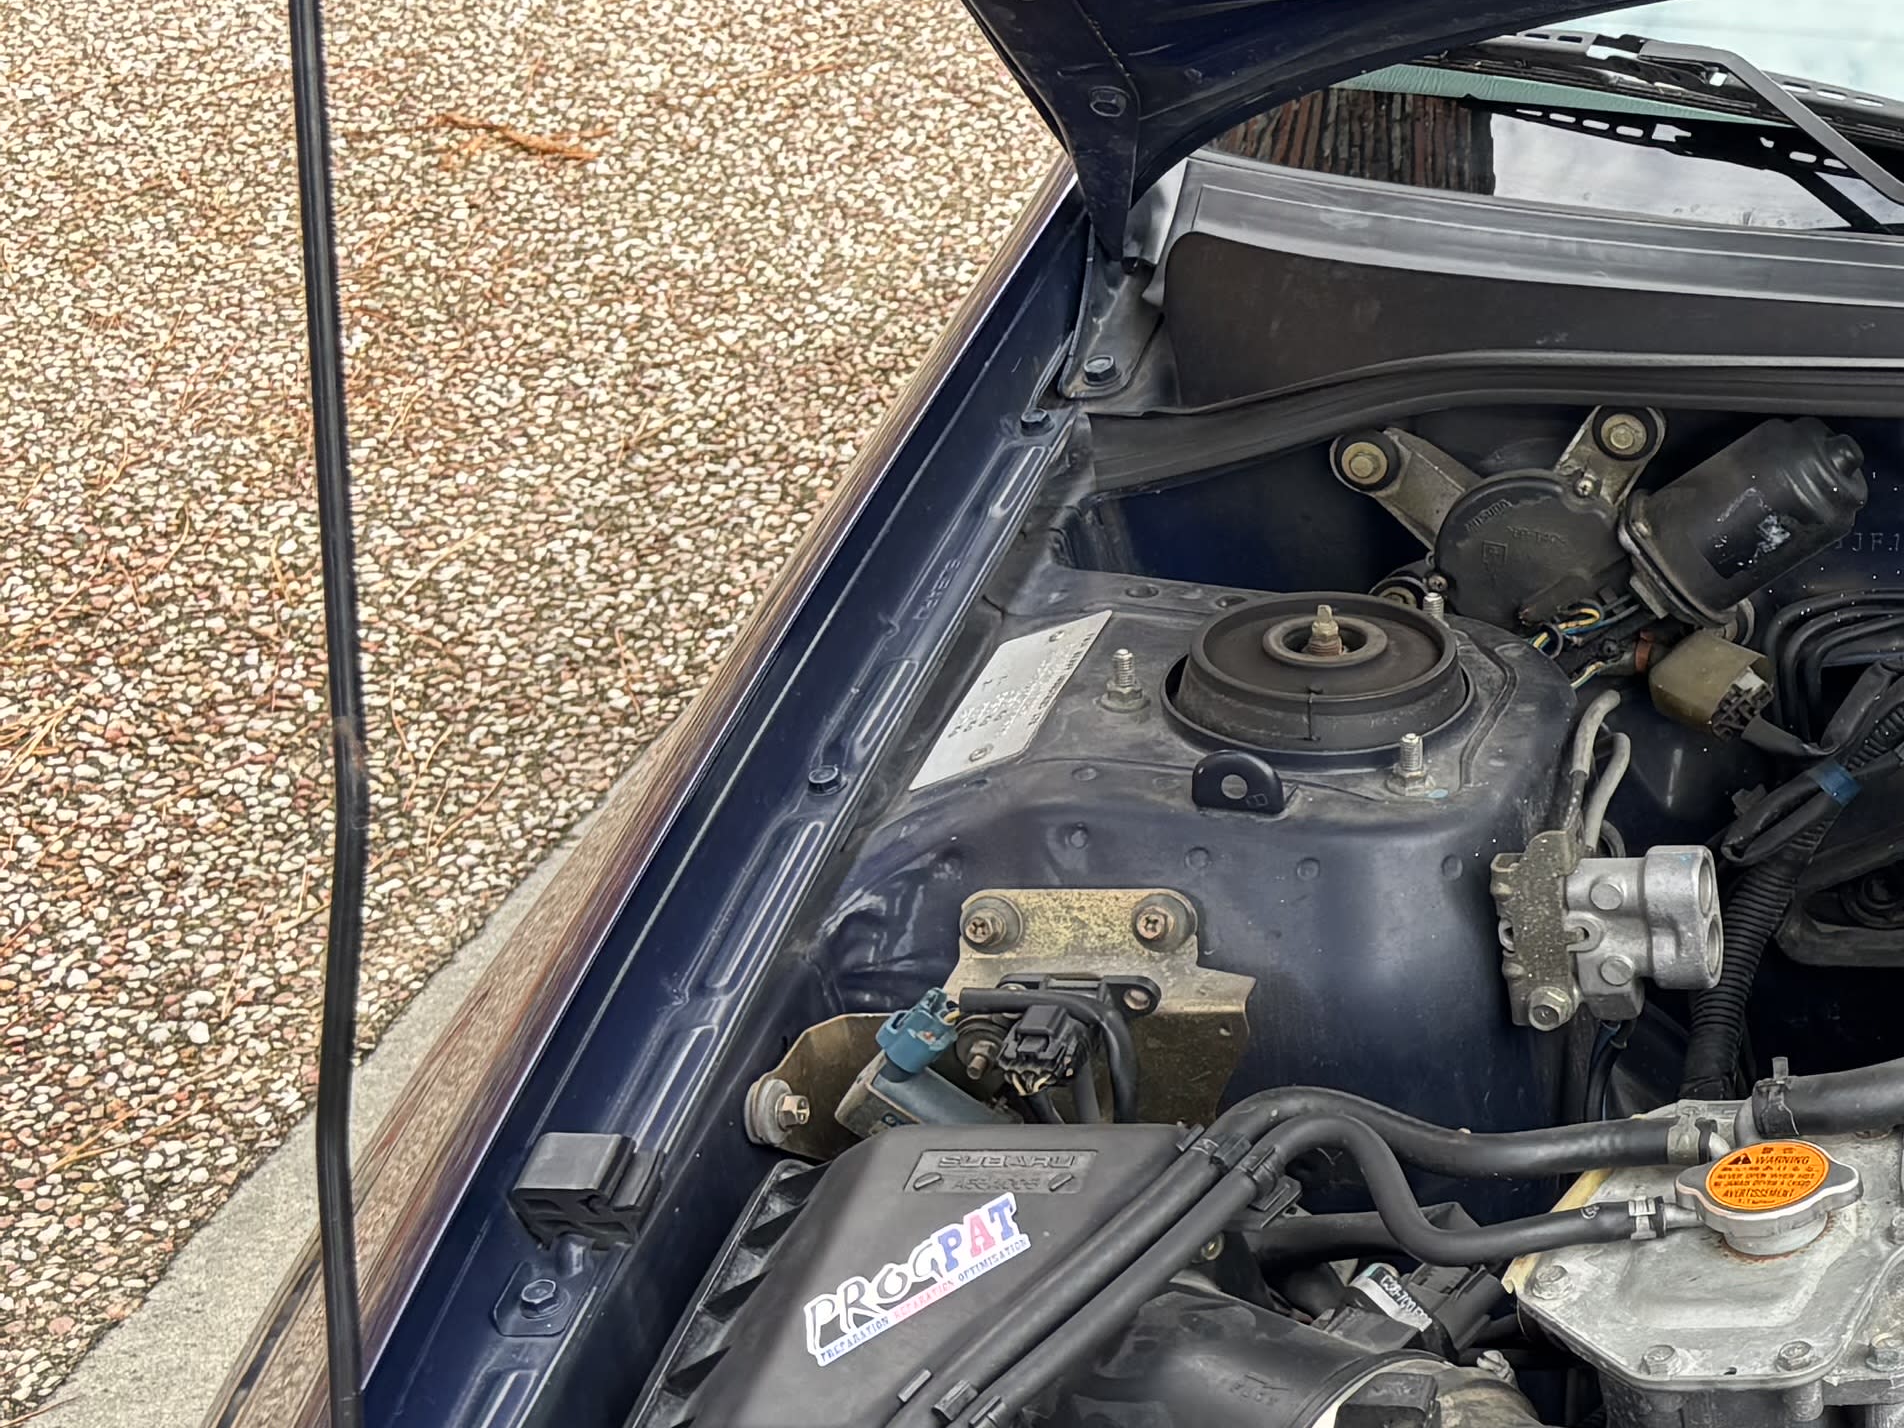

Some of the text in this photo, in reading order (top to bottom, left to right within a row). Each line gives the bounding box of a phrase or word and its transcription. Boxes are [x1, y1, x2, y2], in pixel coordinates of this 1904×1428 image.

[939, 1155, 1075, 1168] SUBARU
[1755, 1156, 1810, 1164] WARNING
[1723, 1189, 1794, 1198] AVERTISSEMENT
